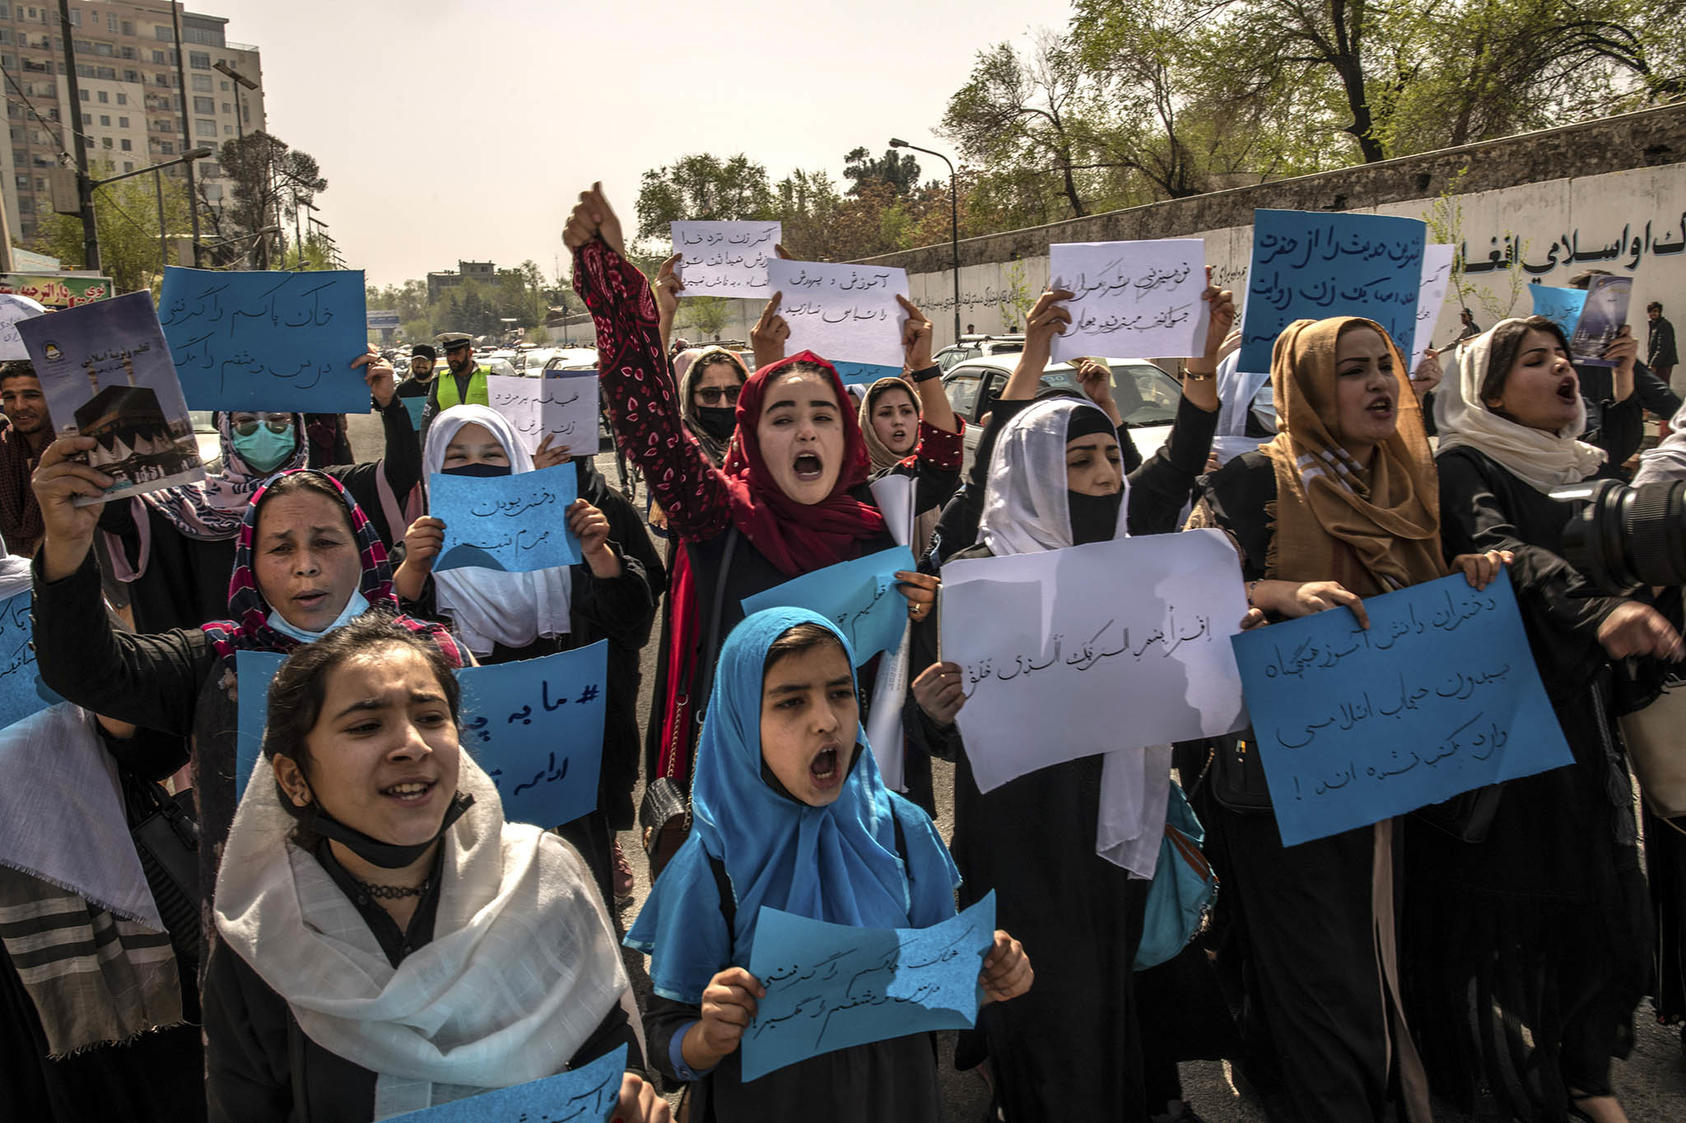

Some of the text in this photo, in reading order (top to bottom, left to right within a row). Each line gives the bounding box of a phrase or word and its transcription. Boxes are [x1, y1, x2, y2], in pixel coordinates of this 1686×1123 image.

[1289, 228, 1320, 269] از
[1321, 224, 1340, 261] را
[1299, 276, 1337, 307] زن
[1432, 588, 1497, 632] دختران
